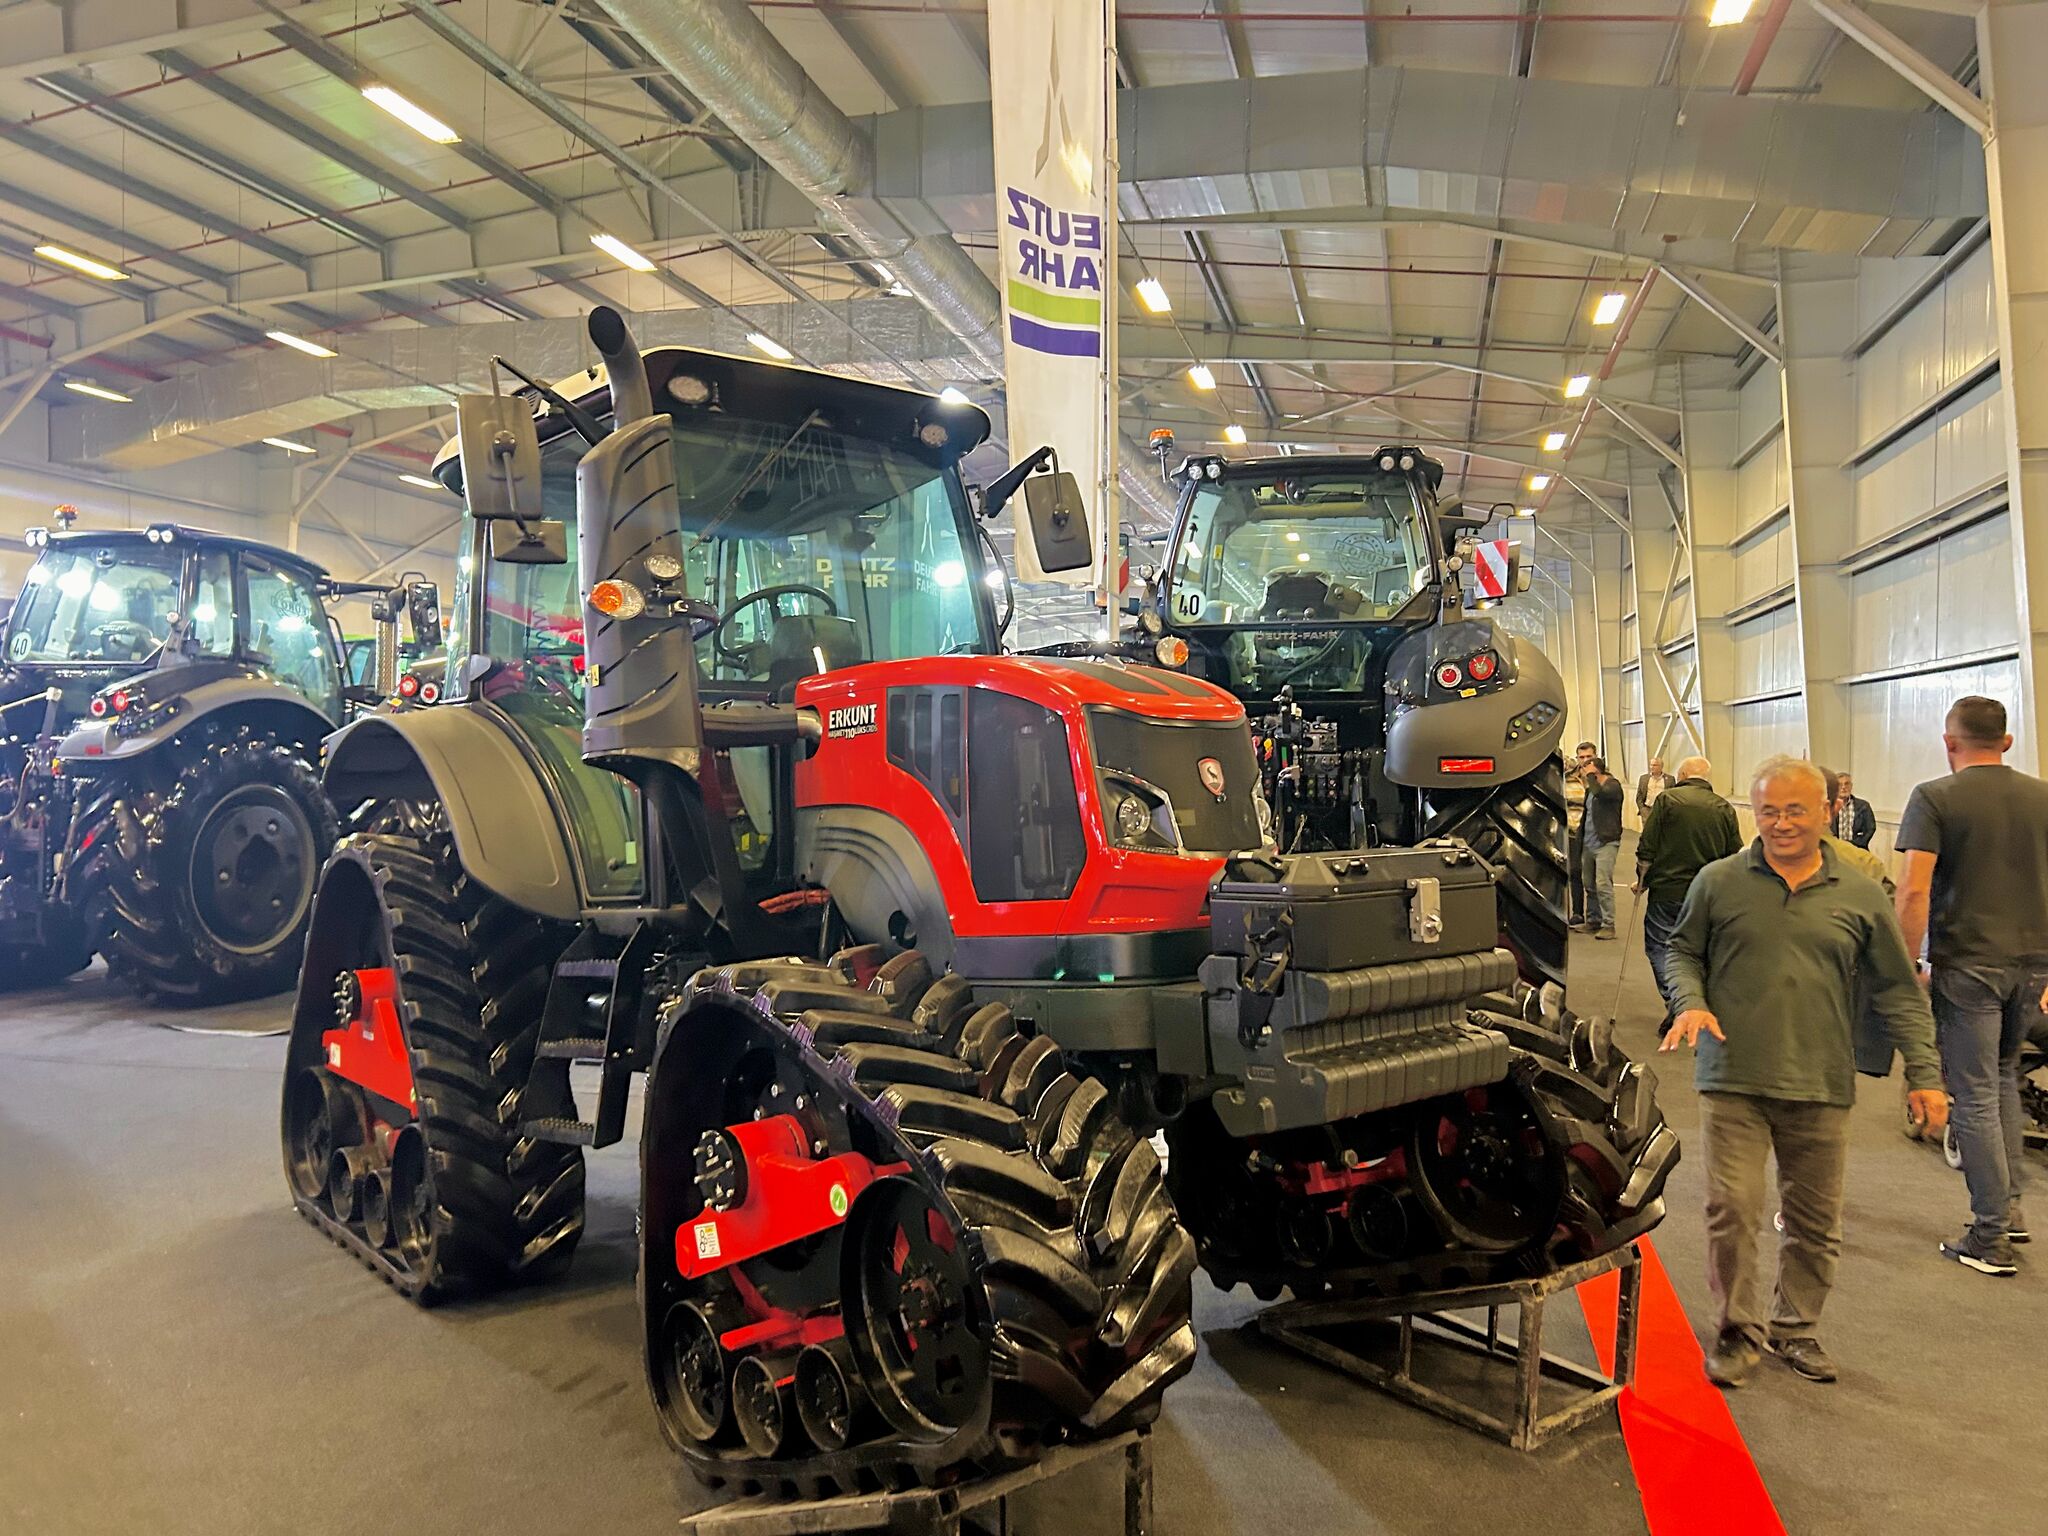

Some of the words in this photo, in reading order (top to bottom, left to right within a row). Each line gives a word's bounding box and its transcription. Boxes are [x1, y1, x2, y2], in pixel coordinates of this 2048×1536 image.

[816, 557, 896, 573] DTZ
[823, 573, 889, 588] FHR
[1178, 594, 1200, 616] 40
[13, 638, 28, 656] 40
[829, 703, 878, 729] ERKUNT
